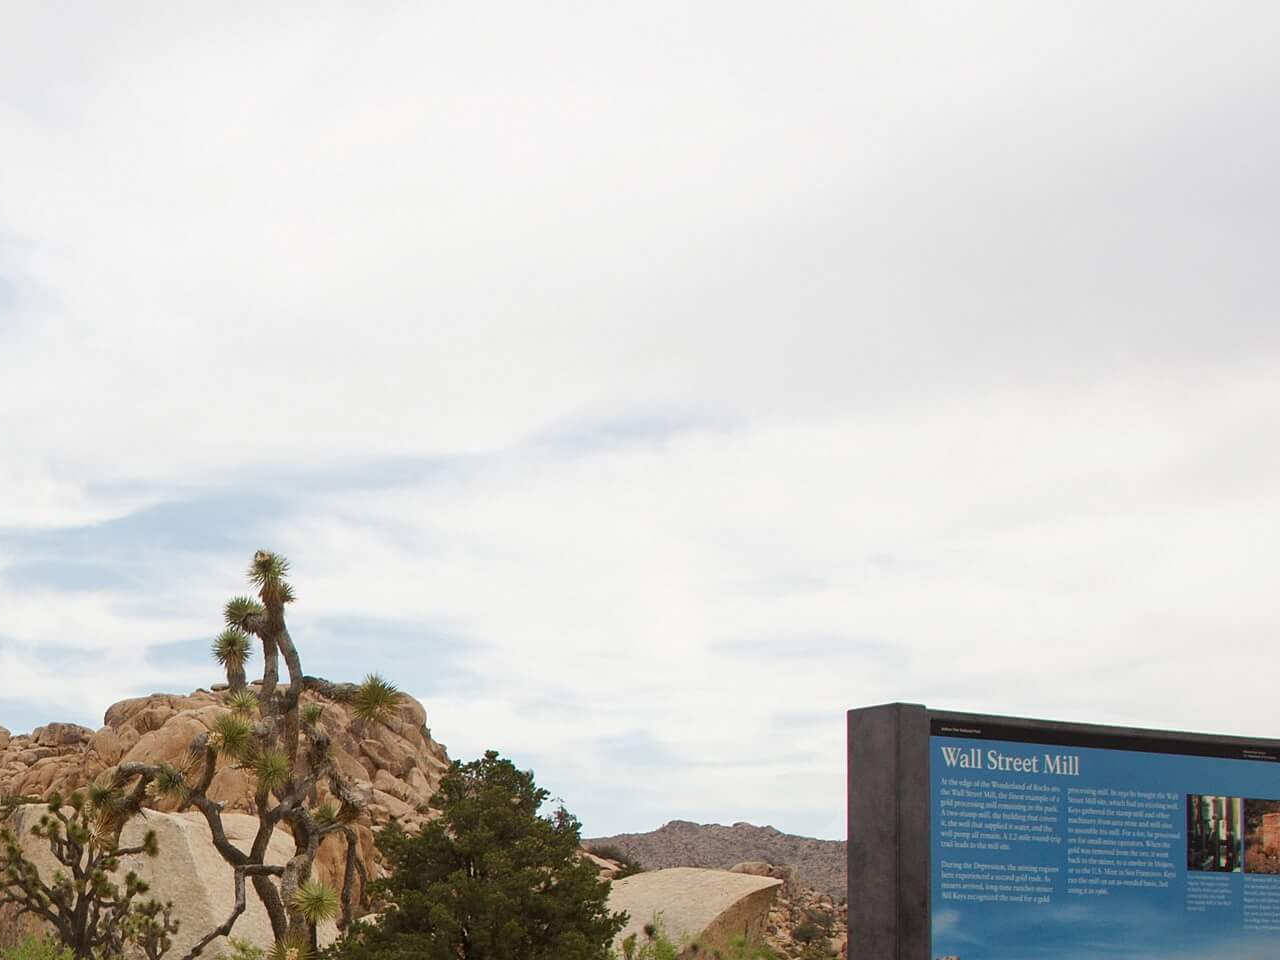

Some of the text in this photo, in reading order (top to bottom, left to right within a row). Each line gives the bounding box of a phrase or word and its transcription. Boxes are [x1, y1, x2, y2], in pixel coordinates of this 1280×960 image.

[941, 746, 1080, 776] Wall Street Mill
